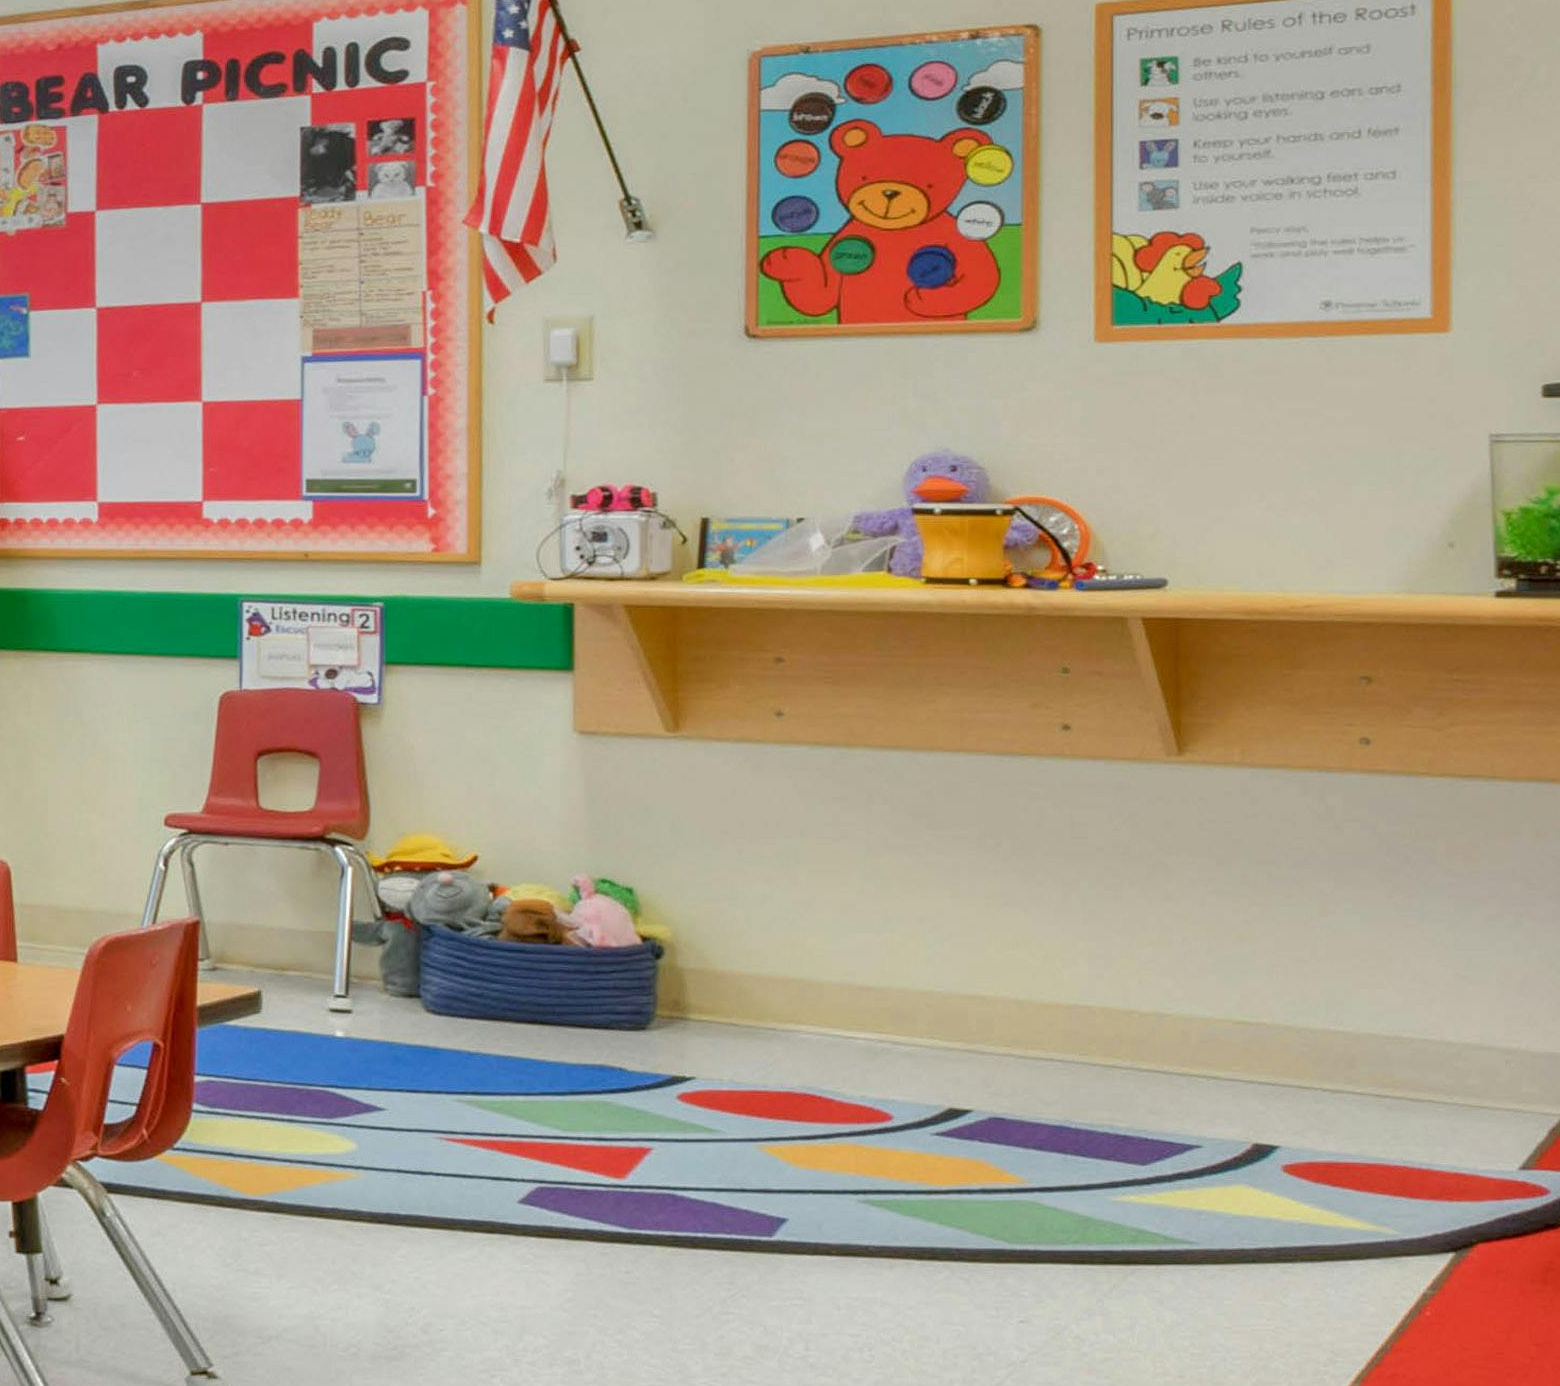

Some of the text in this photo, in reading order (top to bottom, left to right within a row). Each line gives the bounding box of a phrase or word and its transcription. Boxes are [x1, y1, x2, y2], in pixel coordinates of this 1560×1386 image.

[1126, 3, 1418, 41] Primrose Rules of the Roost
[1216, 53, 1248, 66] kind
[1253, 52, 1269, 63] to
[1272, 46, 1334, 64] yourself
[1337, 44, 1372, 56] and
[180, 37, 412, 105] PICNIC
[1193, 98, 1220, 109] Use
[1224, 96, 1257, 108] your
[1262, 89, 1326, 104] listening
[1368, 84, 1402, 96] and
[1192, 109, 1249, 122] looking
[1193, 126, 1400, 150] Keep your hands and feet
[1192, 169, 1397, 192] Use your walking feet and
[1192, 193, 1235, 206] inside
[1240, 190, 1284, 203] voice
[1289, 188, 1301, 200] in
[270, 606, 370, 629] Listening 2
